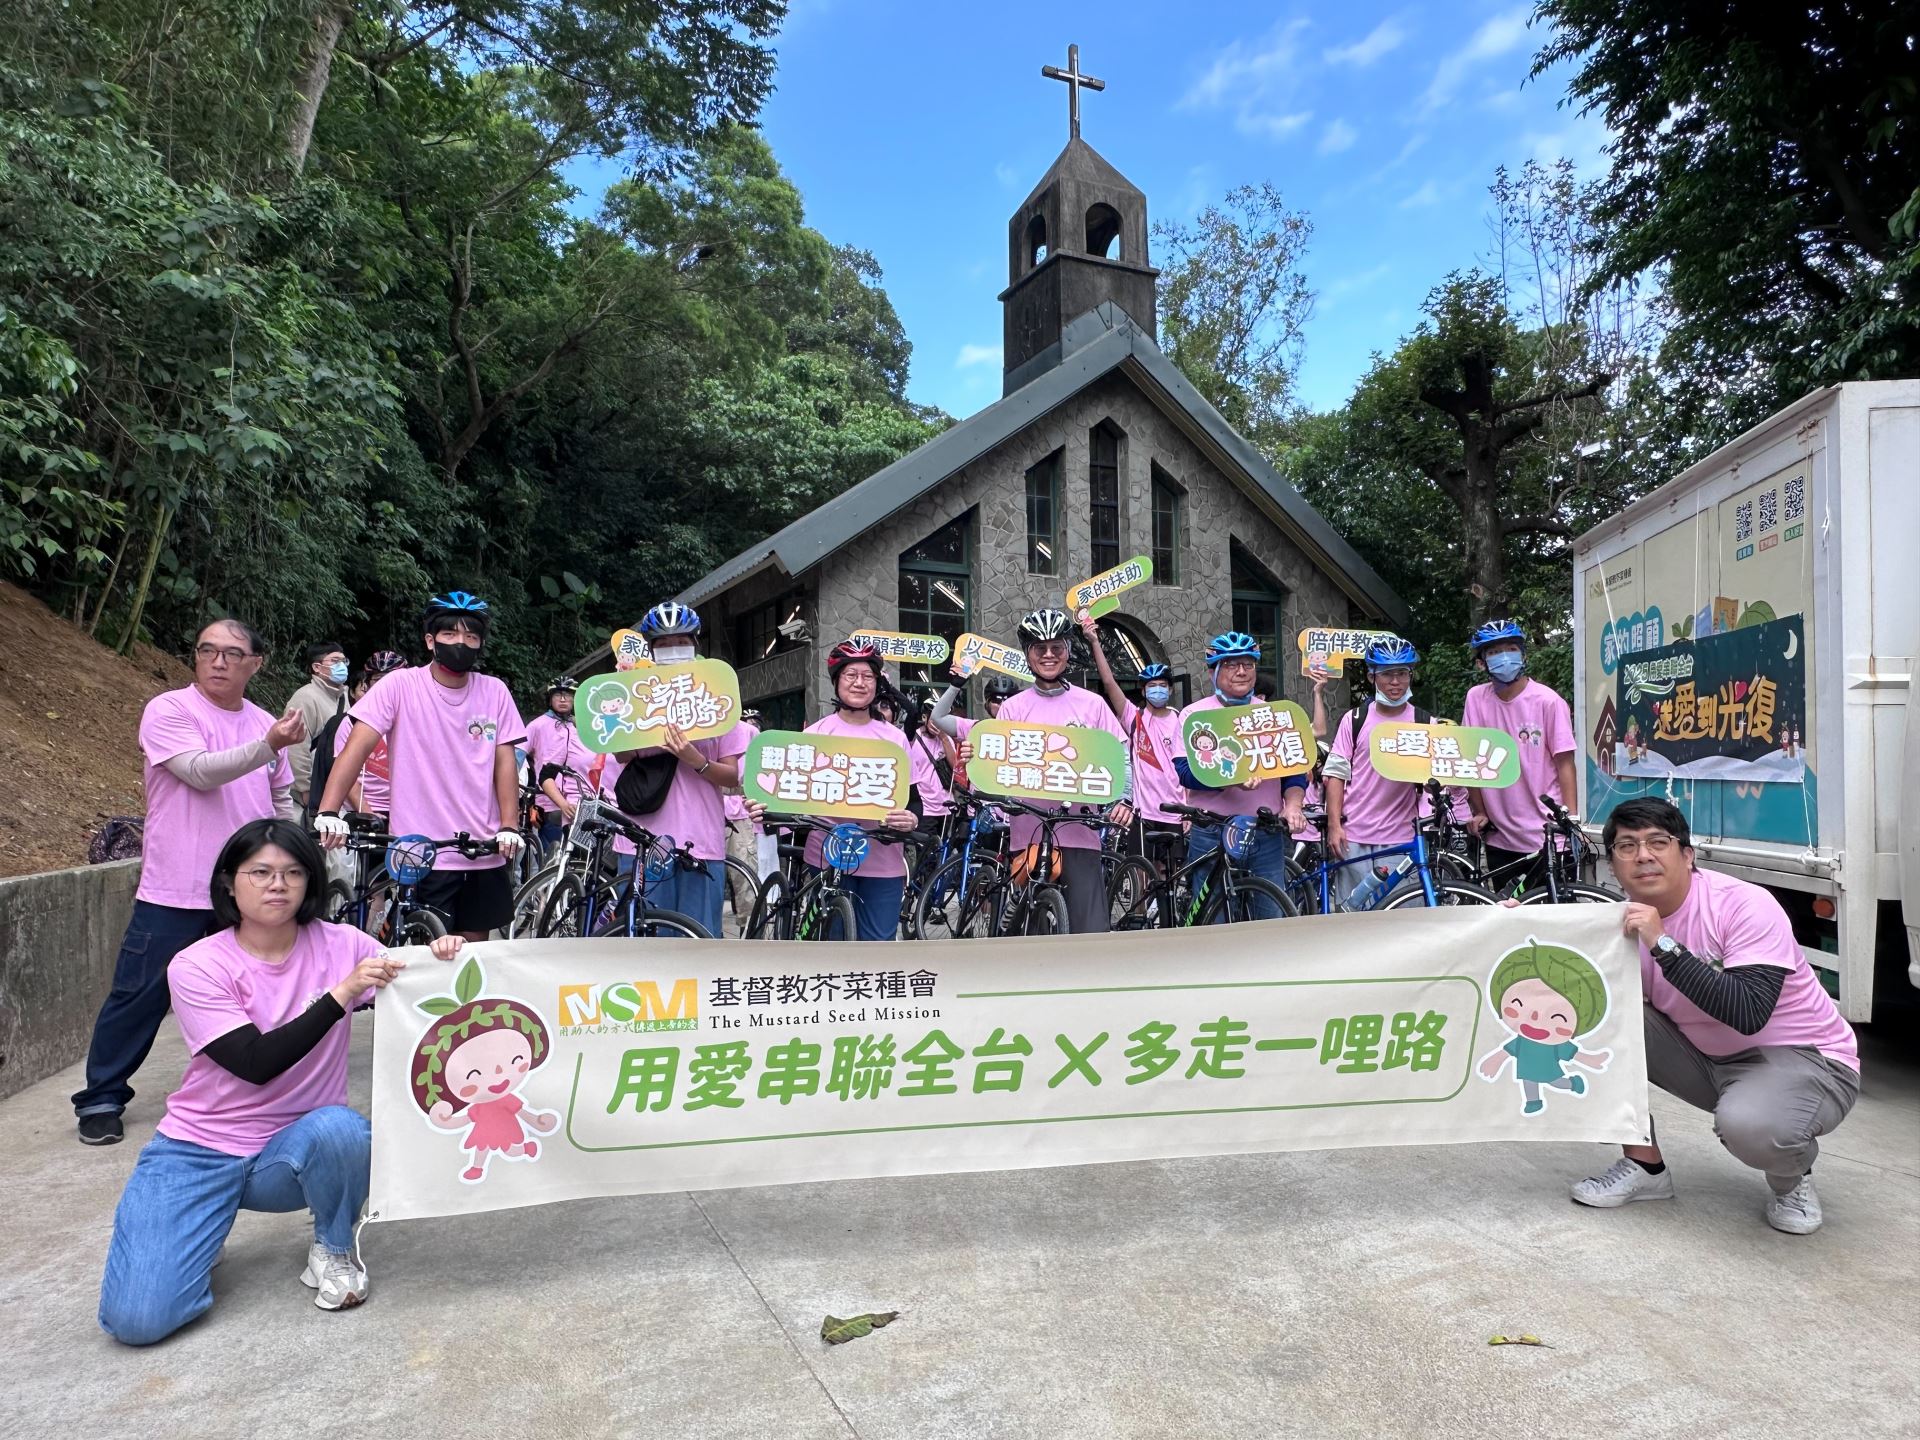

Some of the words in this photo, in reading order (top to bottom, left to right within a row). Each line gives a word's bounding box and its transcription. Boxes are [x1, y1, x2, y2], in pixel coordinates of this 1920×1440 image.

[1077, 563, 1142, 604] 家的扶助
[1653, 674, 1777, 744] 送愛到光復
[979, 729, 1046, 766] 用愛
[1244, 731, 1308, 772] 光復
[1379, 730, 1460, 759] 把愛送
[996, 761, 1113, 796] 串聯全台
[709, 968, 939, 1007] 基督教芥菜種會
[709, 1015, 741, 1029] The
[749, 1010, 820, 1027] Mustard
[828, 1007, 866, 1023] Seed
[874, 1006, 941, 1021] Mission
